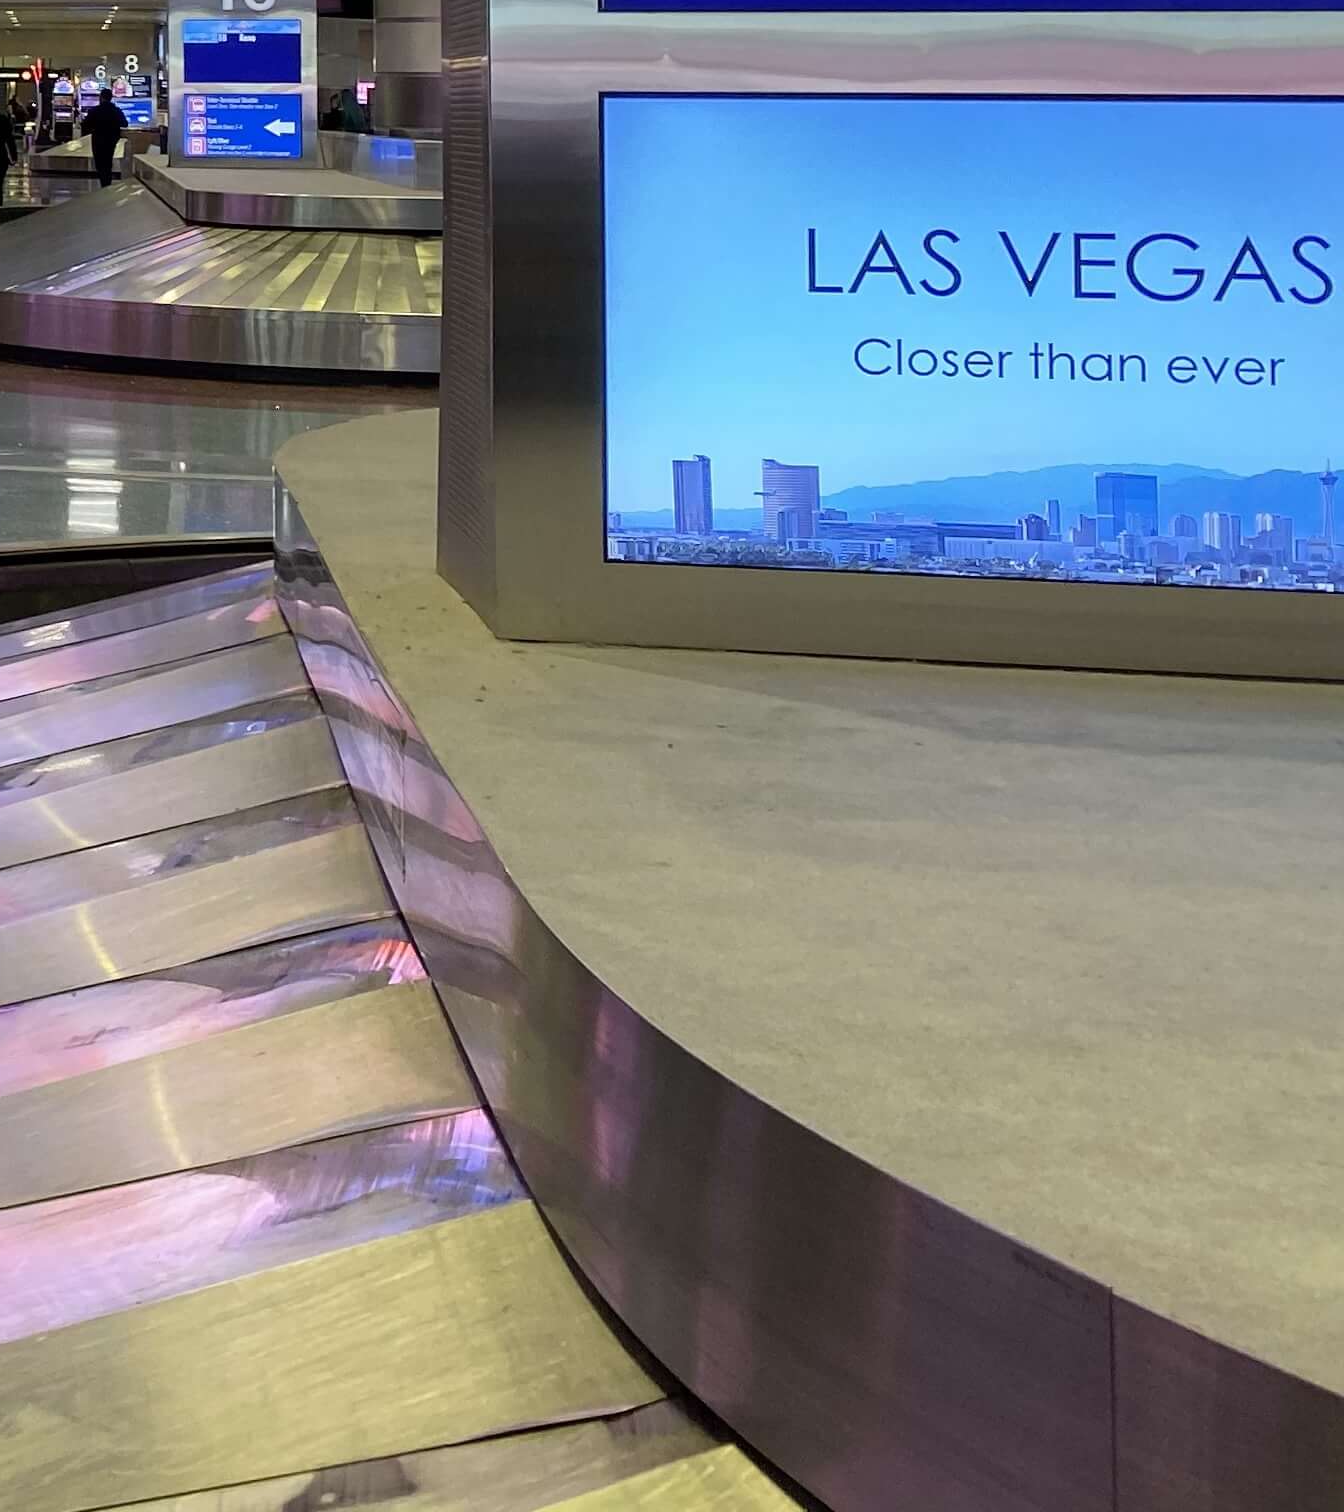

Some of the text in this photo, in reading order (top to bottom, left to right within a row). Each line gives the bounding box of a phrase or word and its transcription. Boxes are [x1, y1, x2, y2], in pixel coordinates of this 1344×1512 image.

[95, 65, 107, 79] 6
[124, 54, 139, 73] 8
[808, 227, 1334, 305] LAS VEGAS
[854, 338, 1284, 386] Closer than ever
